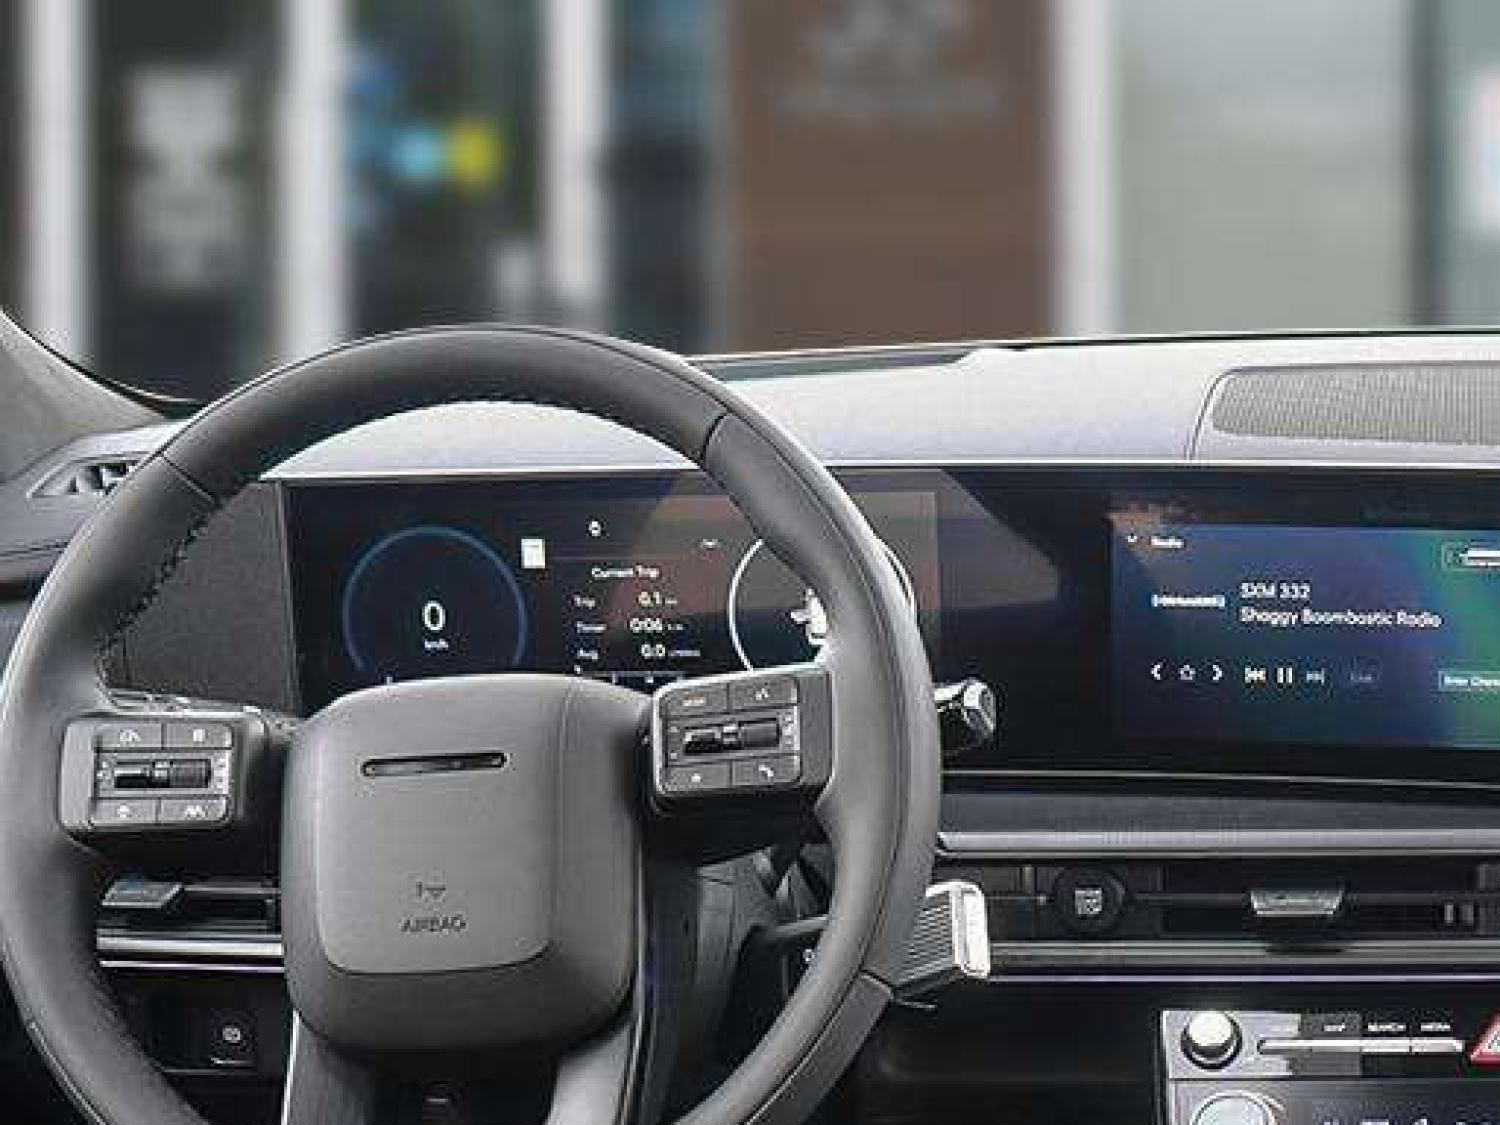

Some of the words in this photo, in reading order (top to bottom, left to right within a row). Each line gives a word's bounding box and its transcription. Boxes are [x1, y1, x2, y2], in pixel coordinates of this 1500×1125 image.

[422, 600, 446, 631] 0
[1242, 606, 1298, 627] Shaggy
[401, 914, 466, 932] AIRBAG
